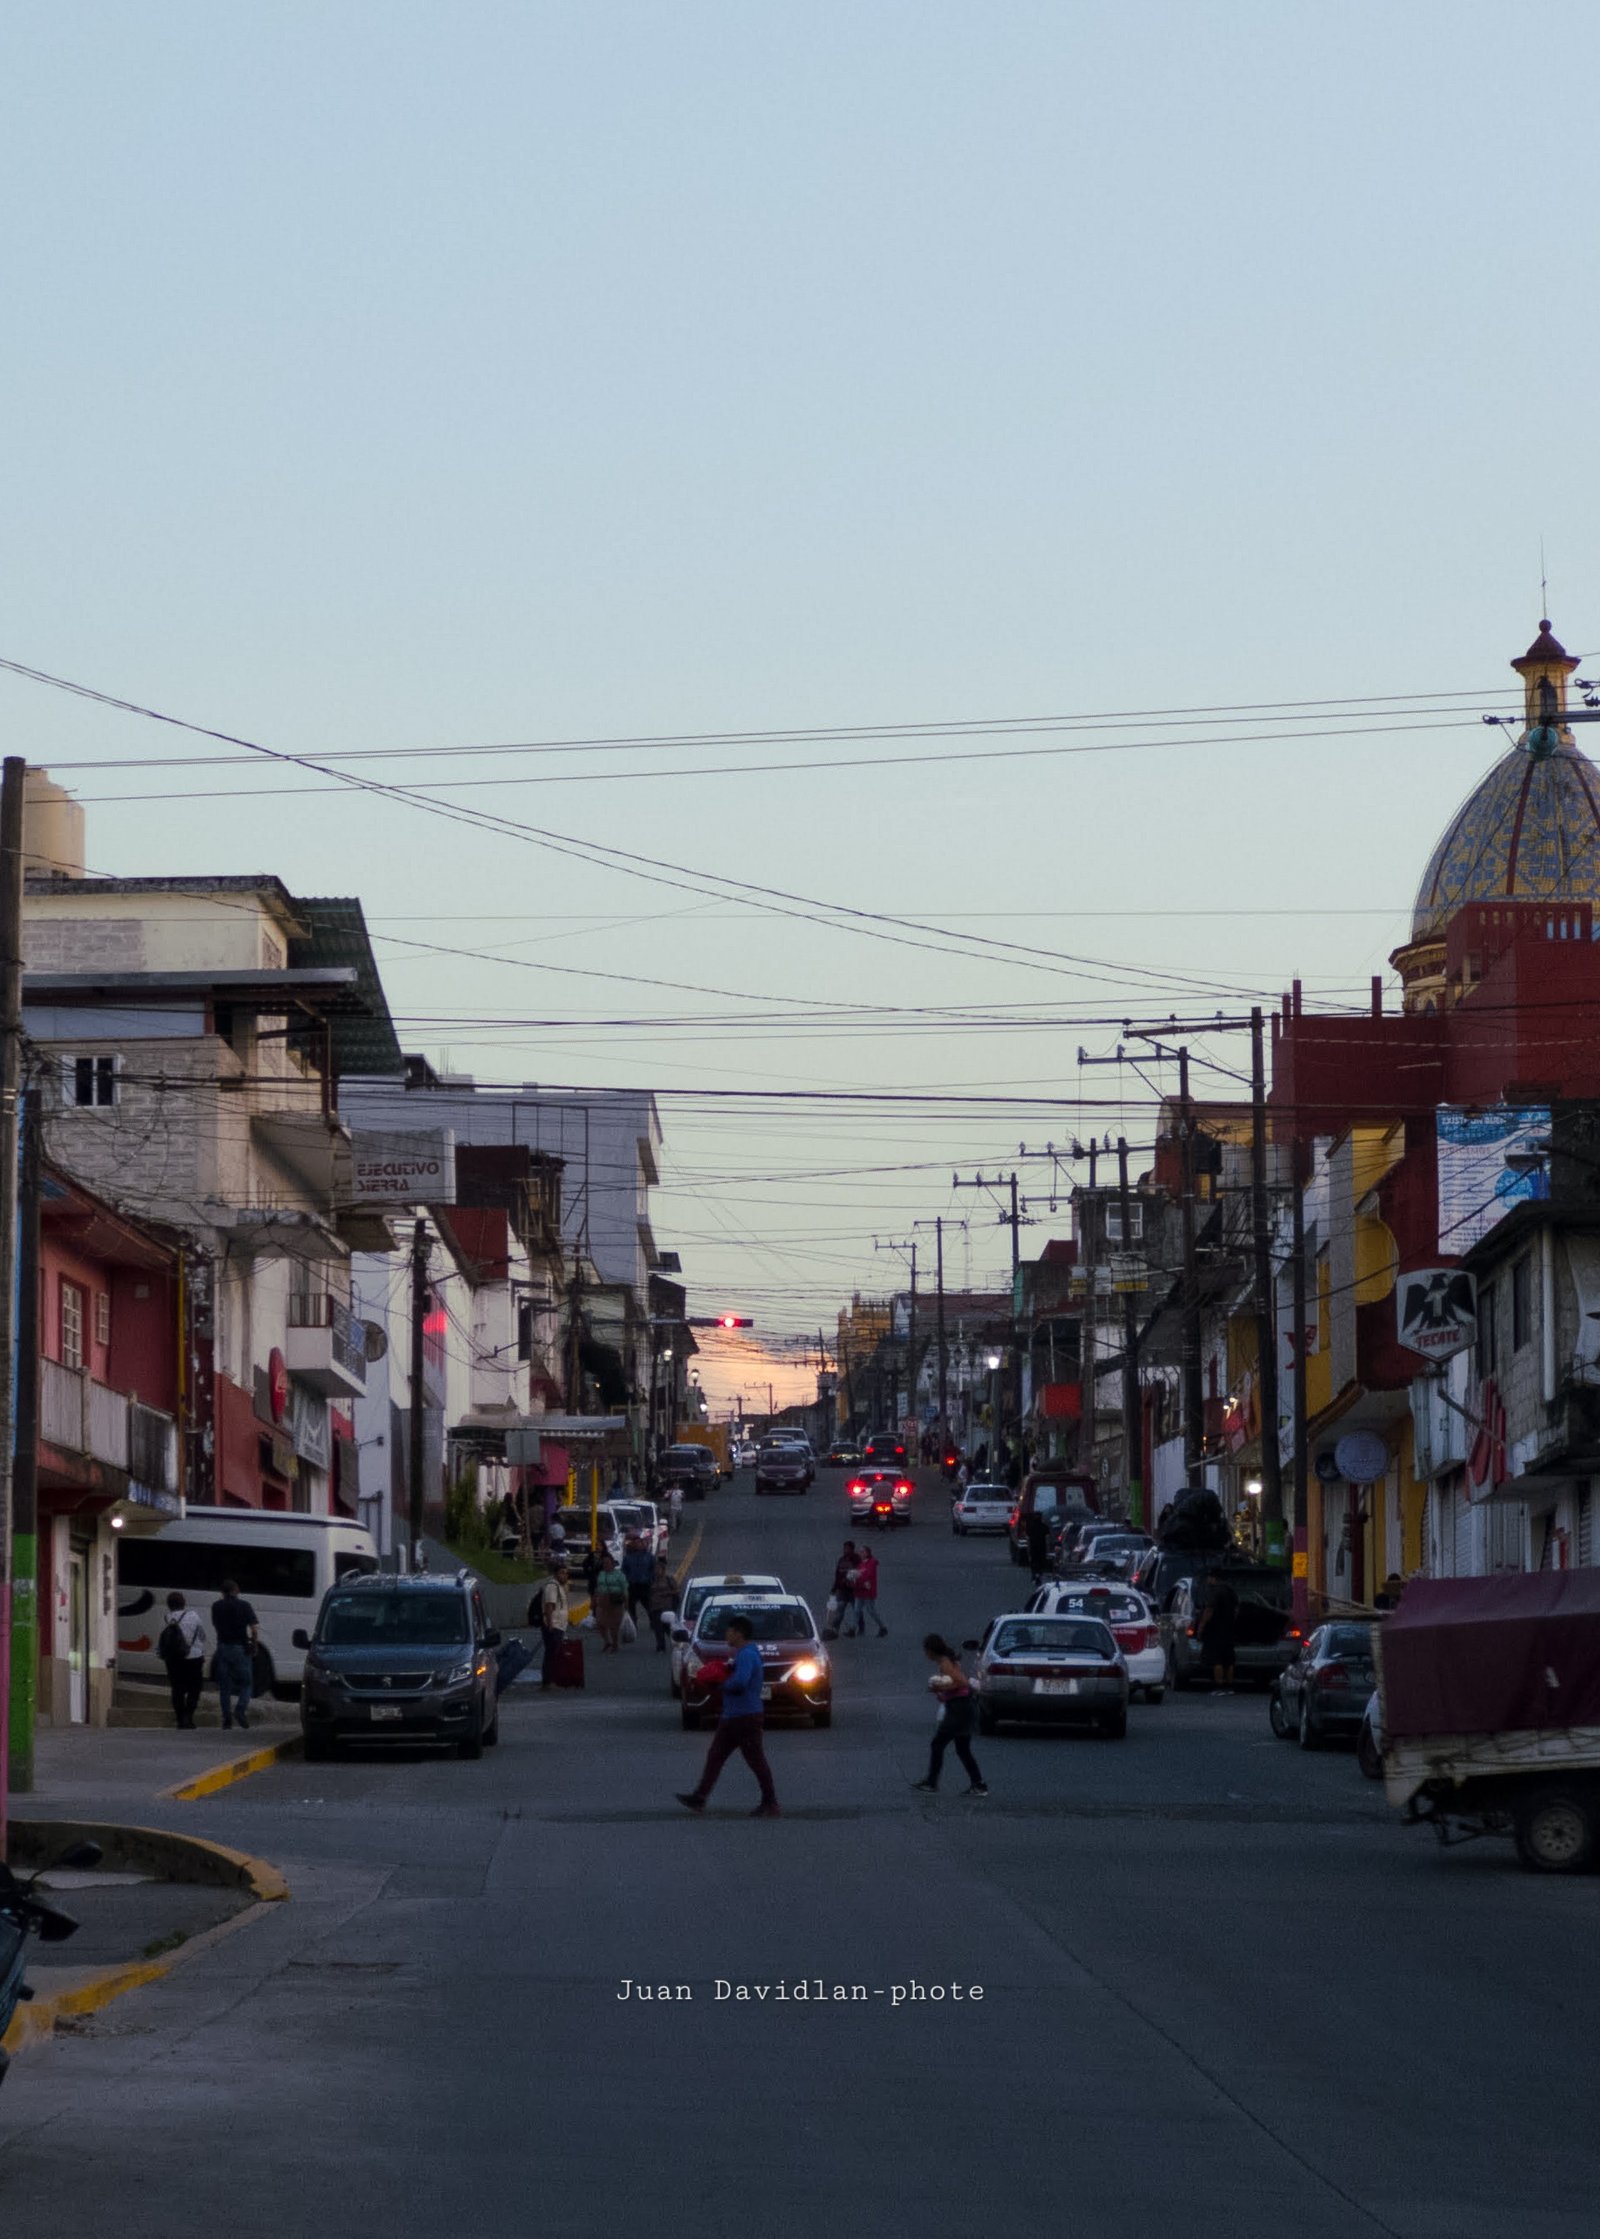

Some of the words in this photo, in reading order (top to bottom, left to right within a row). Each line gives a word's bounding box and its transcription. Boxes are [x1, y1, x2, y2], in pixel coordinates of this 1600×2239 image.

[357, 1161, 440, 1177] EJECUTIVO
[357, 1179, 411, 1193] SIERRA
[1416, 1328, 1461, 1348] TECATE
[1067, 1598, 1084, 1609] 54
